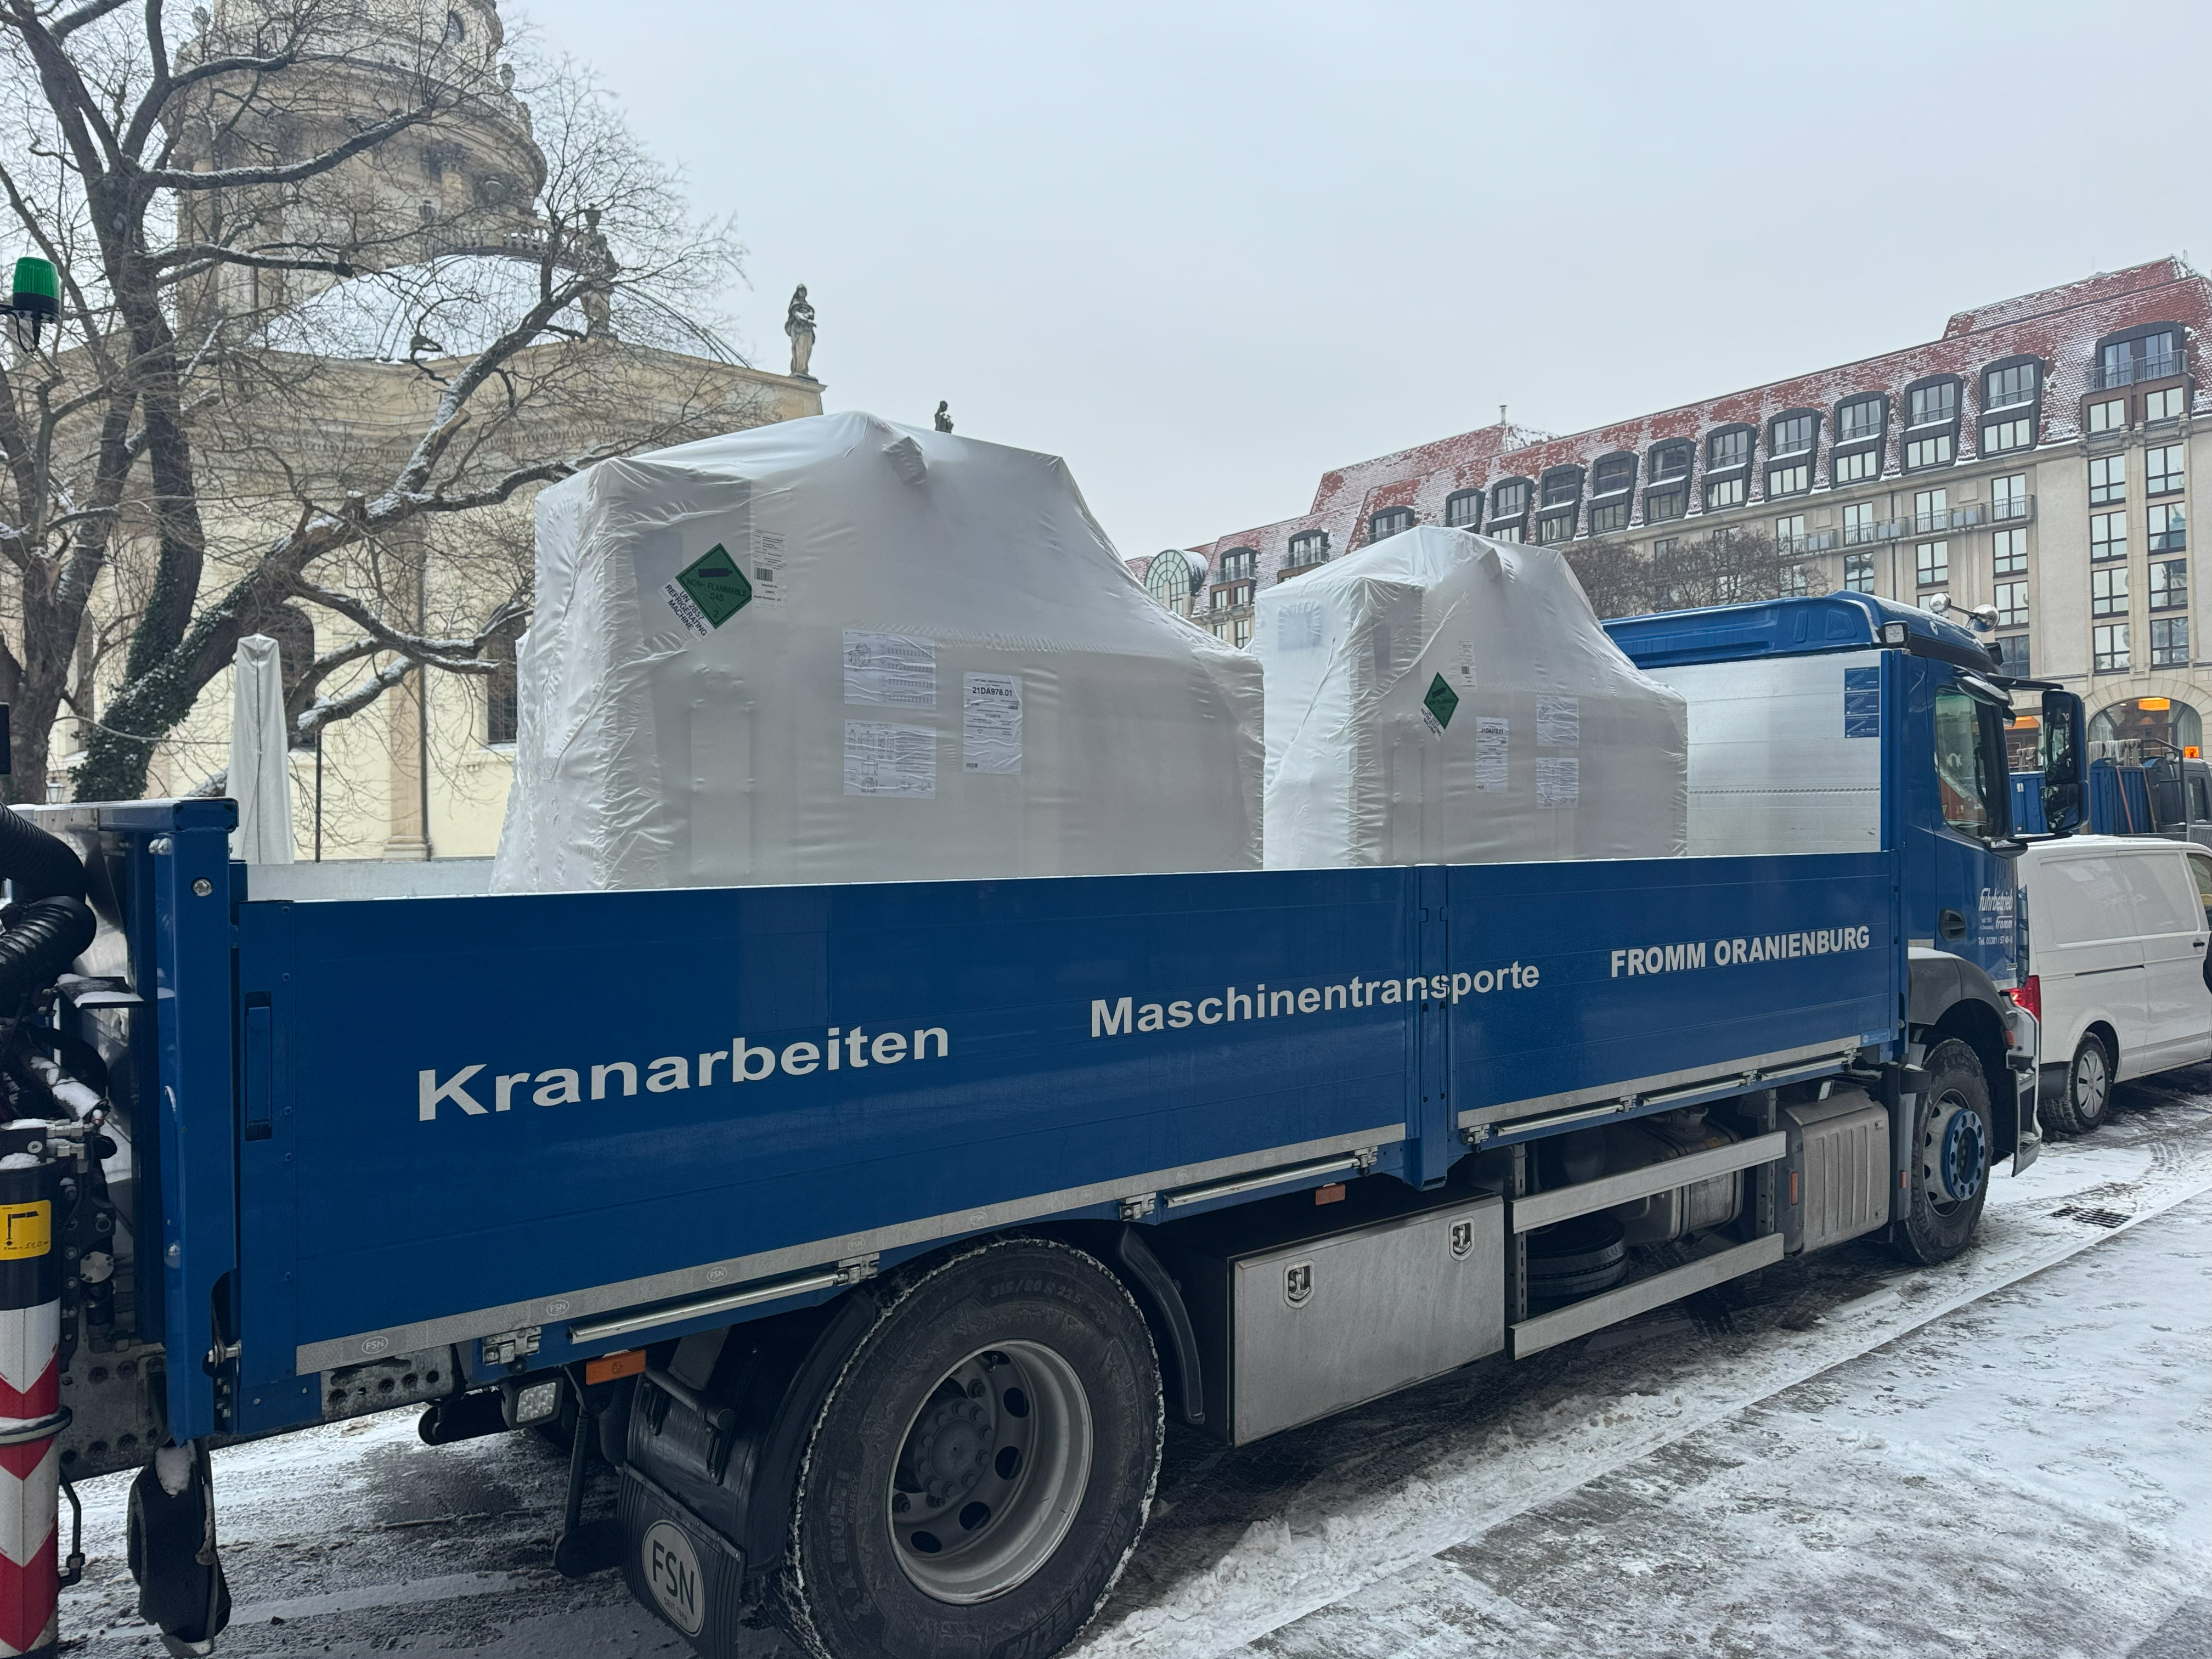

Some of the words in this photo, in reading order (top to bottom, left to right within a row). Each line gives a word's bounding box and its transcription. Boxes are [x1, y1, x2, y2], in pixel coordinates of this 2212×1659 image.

[708, 582, 747, 597] FLAMMABLE
[710, 592, 724, 602] GAS
[665, 584, 708, 636] REFRIGERATING
[668, 599, 695, 631] MACHINE
[679, 591, 690, 603] UN
[689, 602, 705, 620] 2857
[713, 609, 719, 618] 2
[972, 686, 1012, 697] 21DA978.01
[1611, 942, 1706, 978] FROMM
[1714, 926, 1870, 966] ORANIENBURG
[1091, 960, 1540, 1038] Maschinentransporte
[418, 1025, 949, 1122] Kranarbeiten
[710, 1269, 725, 1279] FSN
[550, 1303, 566, 1312] FSN
[365, 1339, 384, 1350] FSN
[848, 1475, 860, 1524] ENERGY
[652, 1538, 695, 1616] FSN
